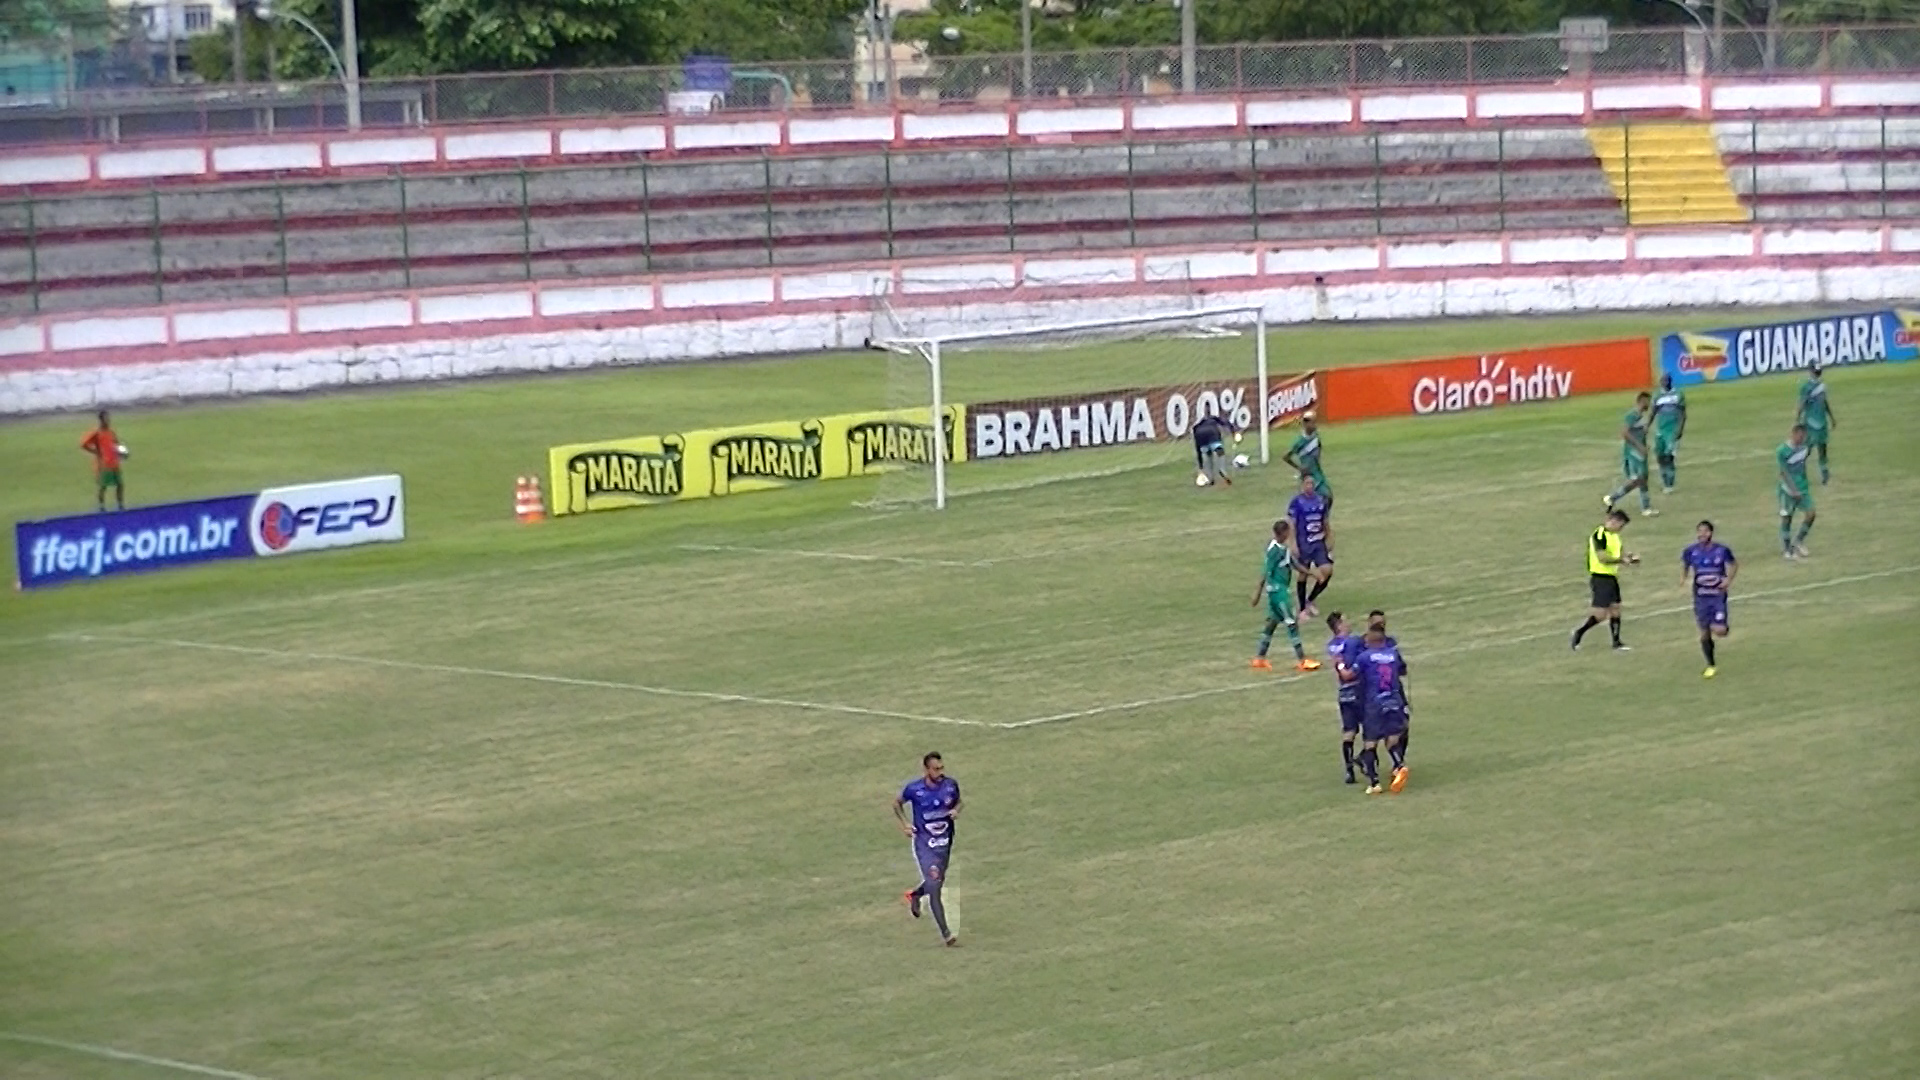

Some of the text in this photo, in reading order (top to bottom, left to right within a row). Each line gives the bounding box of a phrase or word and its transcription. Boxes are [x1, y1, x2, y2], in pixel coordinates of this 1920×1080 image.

[1737, 315, 1886, 376] GUANABARA
[975, 398, 1156, 459] BRAHMA
[1268, 378, 1318, 423] BRAHMA
[32, 515, 238, 577] fferj.com.br
